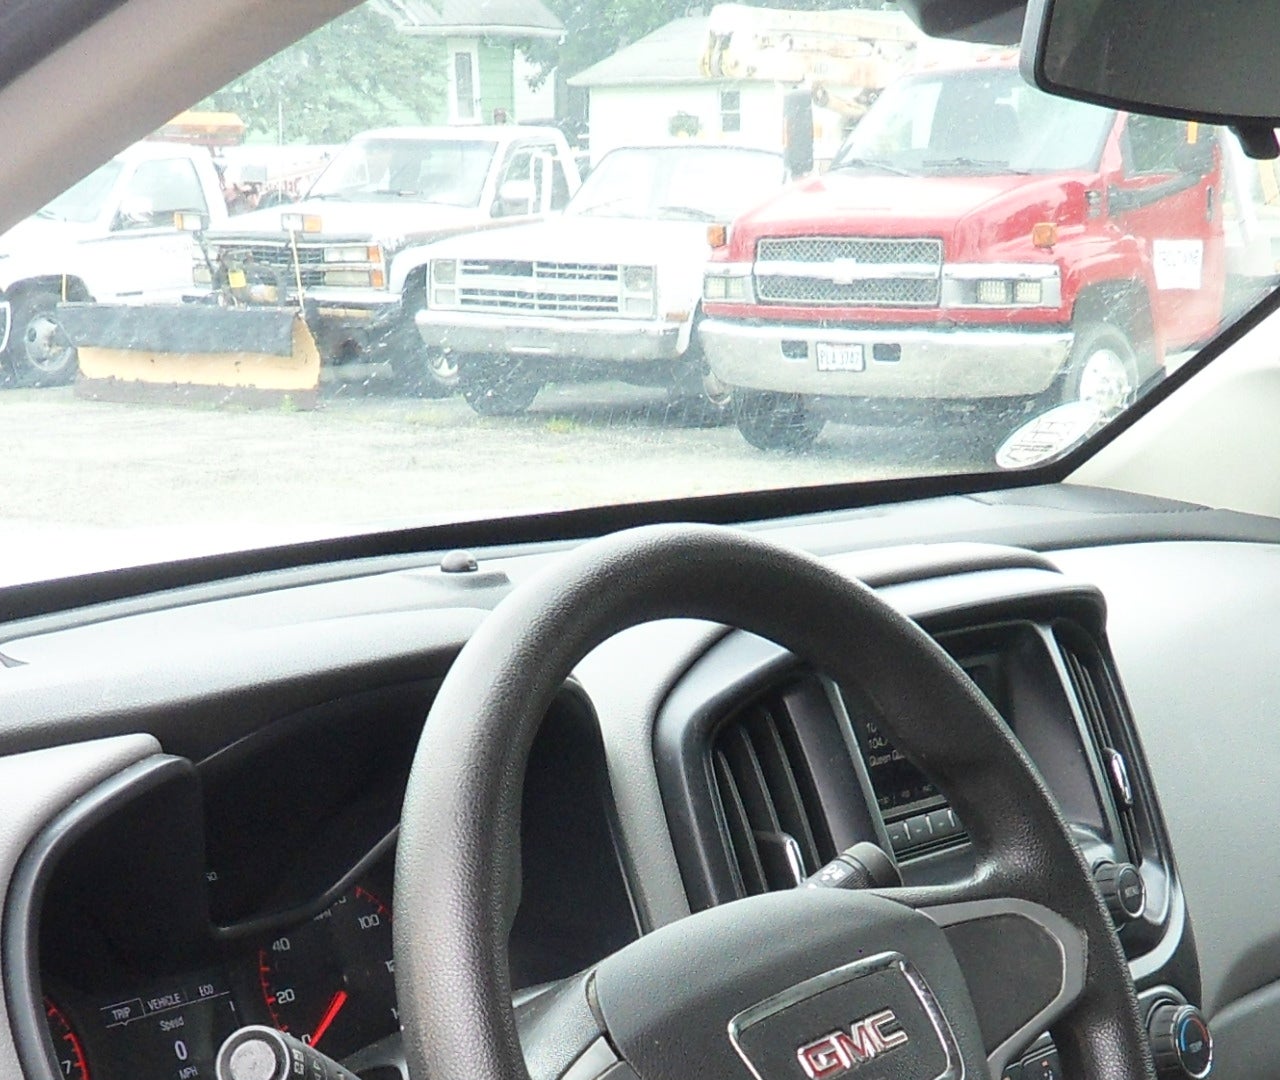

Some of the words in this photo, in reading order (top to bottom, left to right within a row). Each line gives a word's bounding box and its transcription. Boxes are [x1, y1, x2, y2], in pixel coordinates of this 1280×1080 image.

[358, 914, 381, 930] 100
[272, 937, 291, 952] 40
[111, 1007, 131, 1020] TRIP
[147, 993, 181, 1010] VEHICLE
[198, 984, 214, 996] ECO
[277, 989, 296, 1004] 20
[174, 1040, 188, 1060] 0
[61, 1060, 71, 1074] 7
[179, 1066, 198, 1080] MPH
